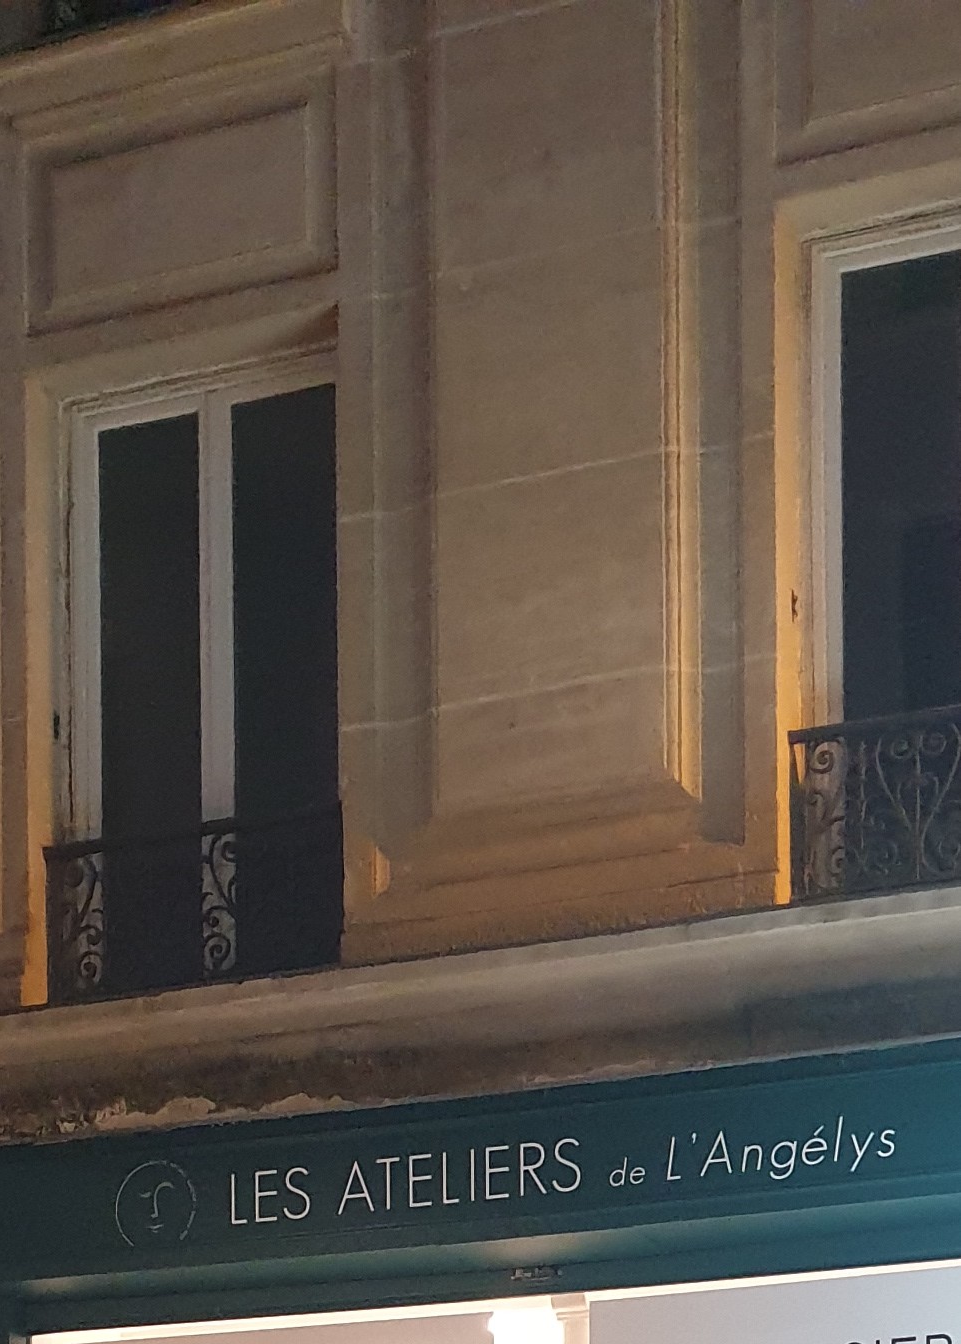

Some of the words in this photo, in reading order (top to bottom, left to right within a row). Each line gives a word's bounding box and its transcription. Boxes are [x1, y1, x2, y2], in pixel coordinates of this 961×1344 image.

[230, 1166, 311, 1225] LES
[338, 1137, 582, 1216] ATELIERS
[608, 1156, 647, 1187] de
[665, 1115, 897, 1182] L'Angélys
